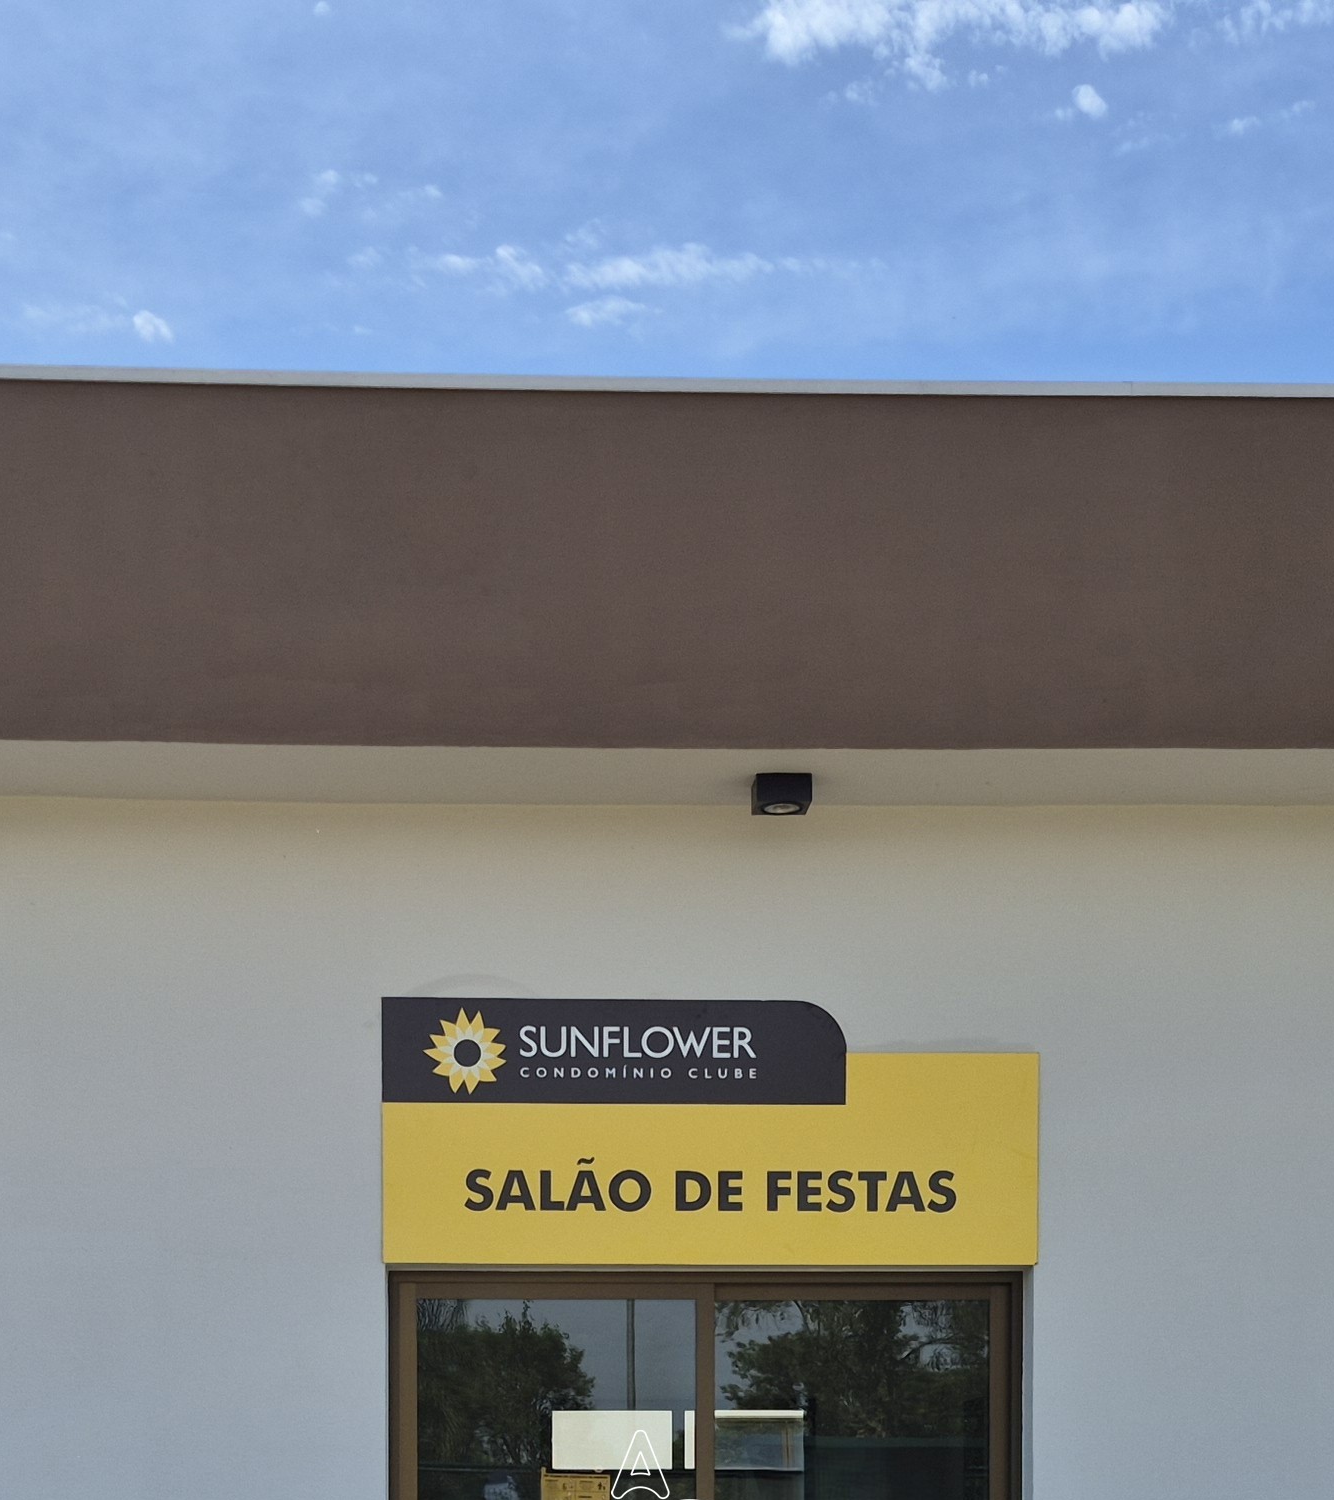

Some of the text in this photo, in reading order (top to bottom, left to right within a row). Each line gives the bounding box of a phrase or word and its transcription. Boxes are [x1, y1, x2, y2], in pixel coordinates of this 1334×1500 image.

[519, 1025, 757, 1059] SUNFLOWER
[519, 1064, 757, 1079] CONDOMÍNIO CLUBE
[464, 1157, 957, 1214] SALÃO DE FESTAS
